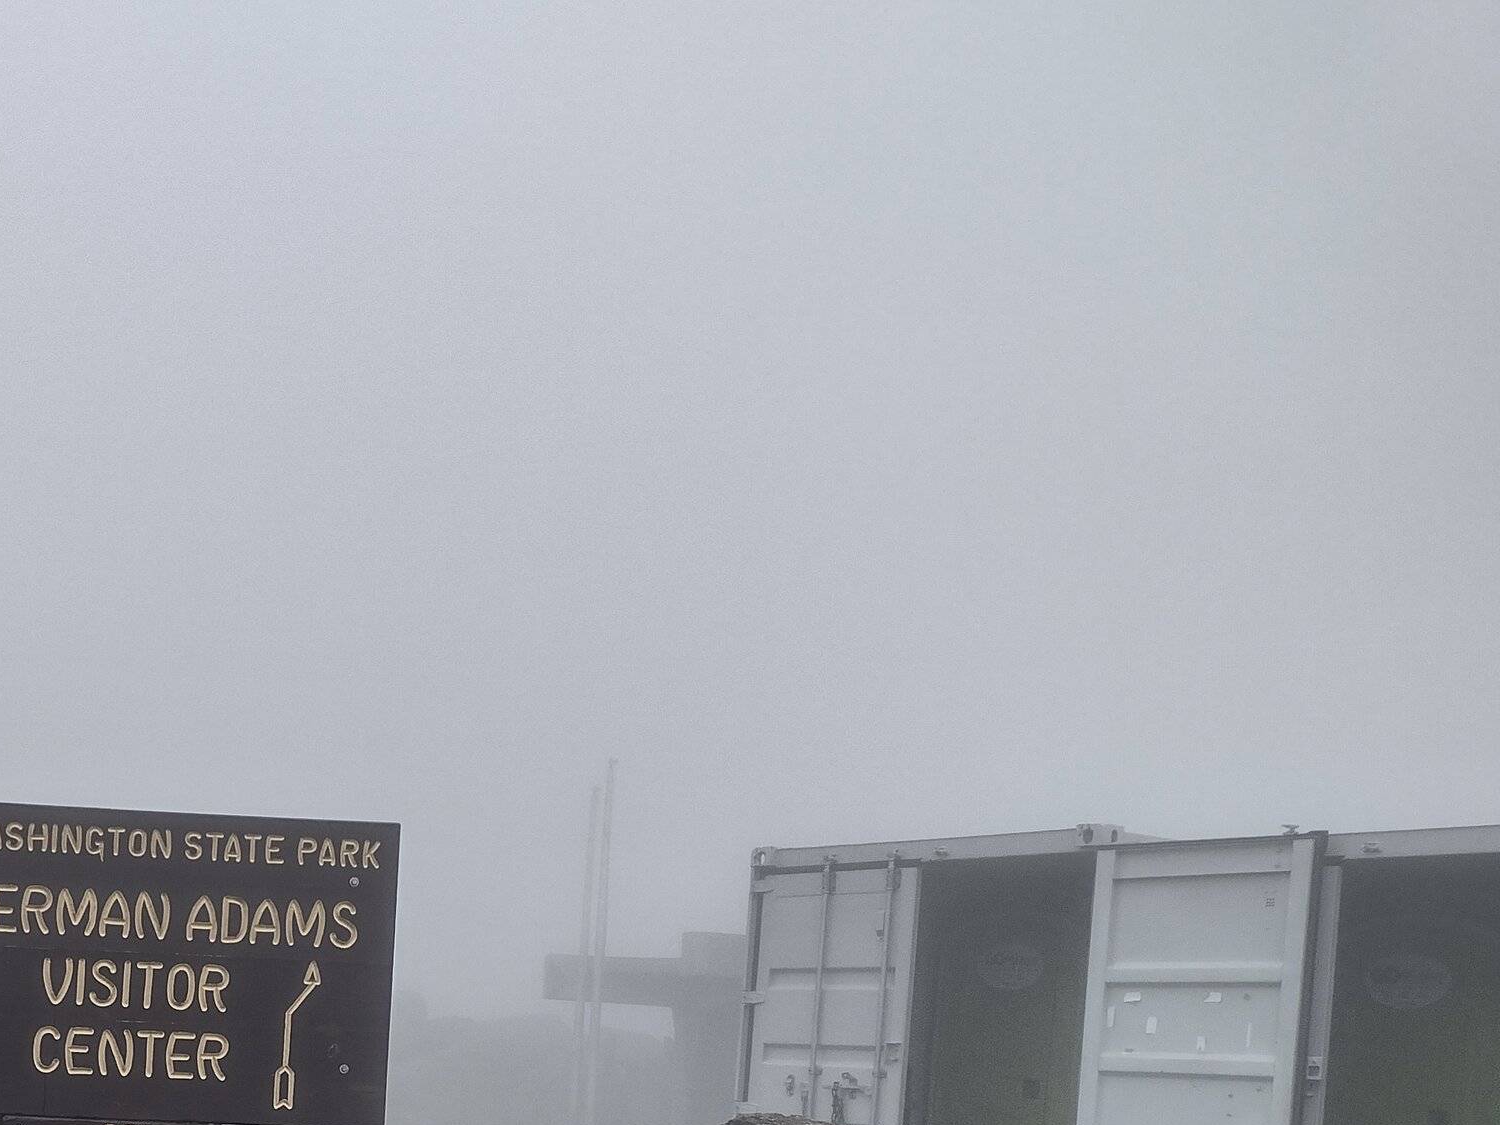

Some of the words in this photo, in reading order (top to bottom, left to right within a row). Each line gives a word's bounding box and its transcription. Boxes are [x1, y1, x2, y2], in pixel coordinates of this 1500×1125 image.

[185, 832, 284, 864] STATE
[298, 838, 380, 869] PARK
[186, 896, 357, 948] ADAMS
[43, 958, 229, 1012] VISITOR
[33, 1027, 229, 1081] CENTER
